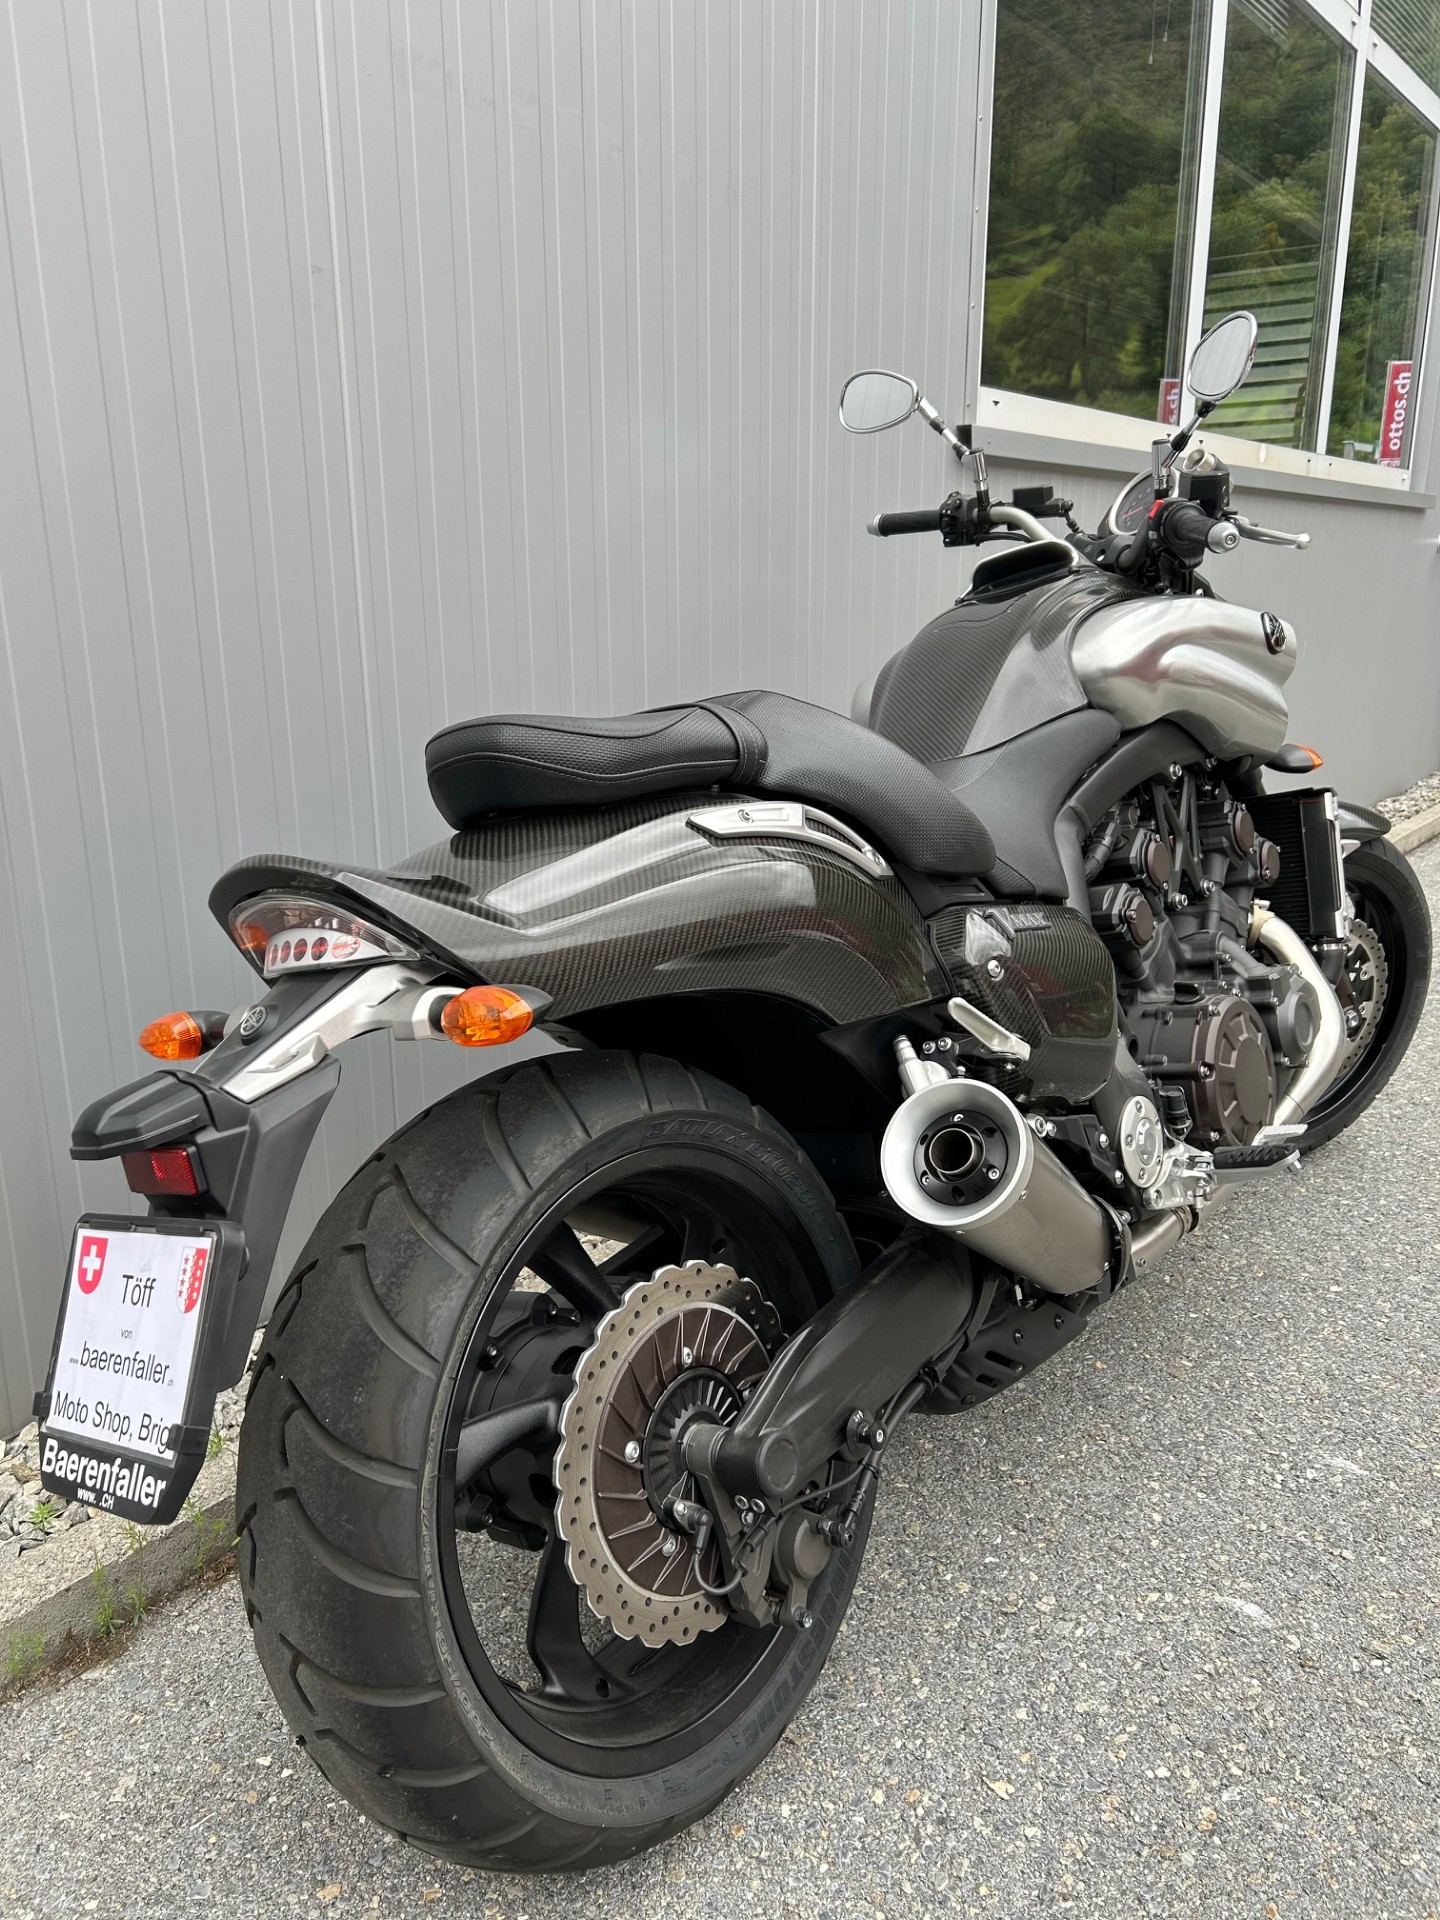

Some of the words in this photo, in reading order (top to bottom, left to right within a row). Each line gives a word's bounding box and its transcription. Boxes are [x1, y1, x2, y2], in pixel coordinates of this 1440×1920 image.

[1388, 371, 1412, 451] ottos.ch
[122, 1273, 156, 1308] Töff
[120, 1328, 133, 1340] von
[53, 1389, 89, 1424] Moto
[93, 1402, 133, 1443] Shop,
[138, 1413, 170, 1454] Brig
[41, 1437, 168, 1509] Baerenfaller
